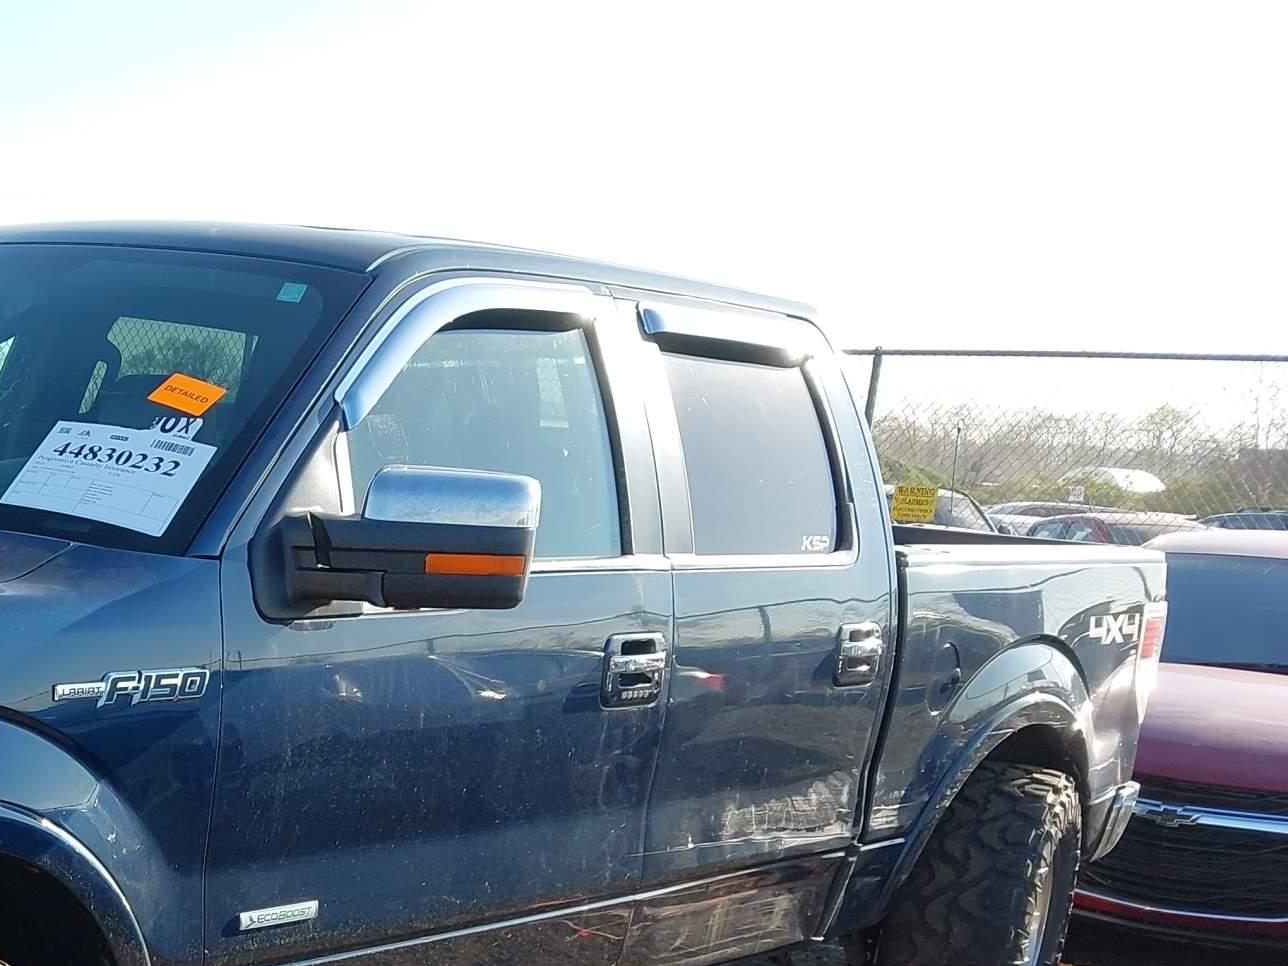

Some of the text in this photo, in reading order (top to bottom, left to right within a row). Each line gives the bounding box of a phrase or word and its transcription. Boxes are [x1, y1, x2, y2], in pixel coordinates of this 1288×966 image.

[164, 385, 209, 404] DETAILED
[52, 441, 181, 477] 44830232
[897, 486, 936, 496] WARNING
[801, 535, 830, 551] KSP
[62, 668, 210, 708] LARIAT F-150
